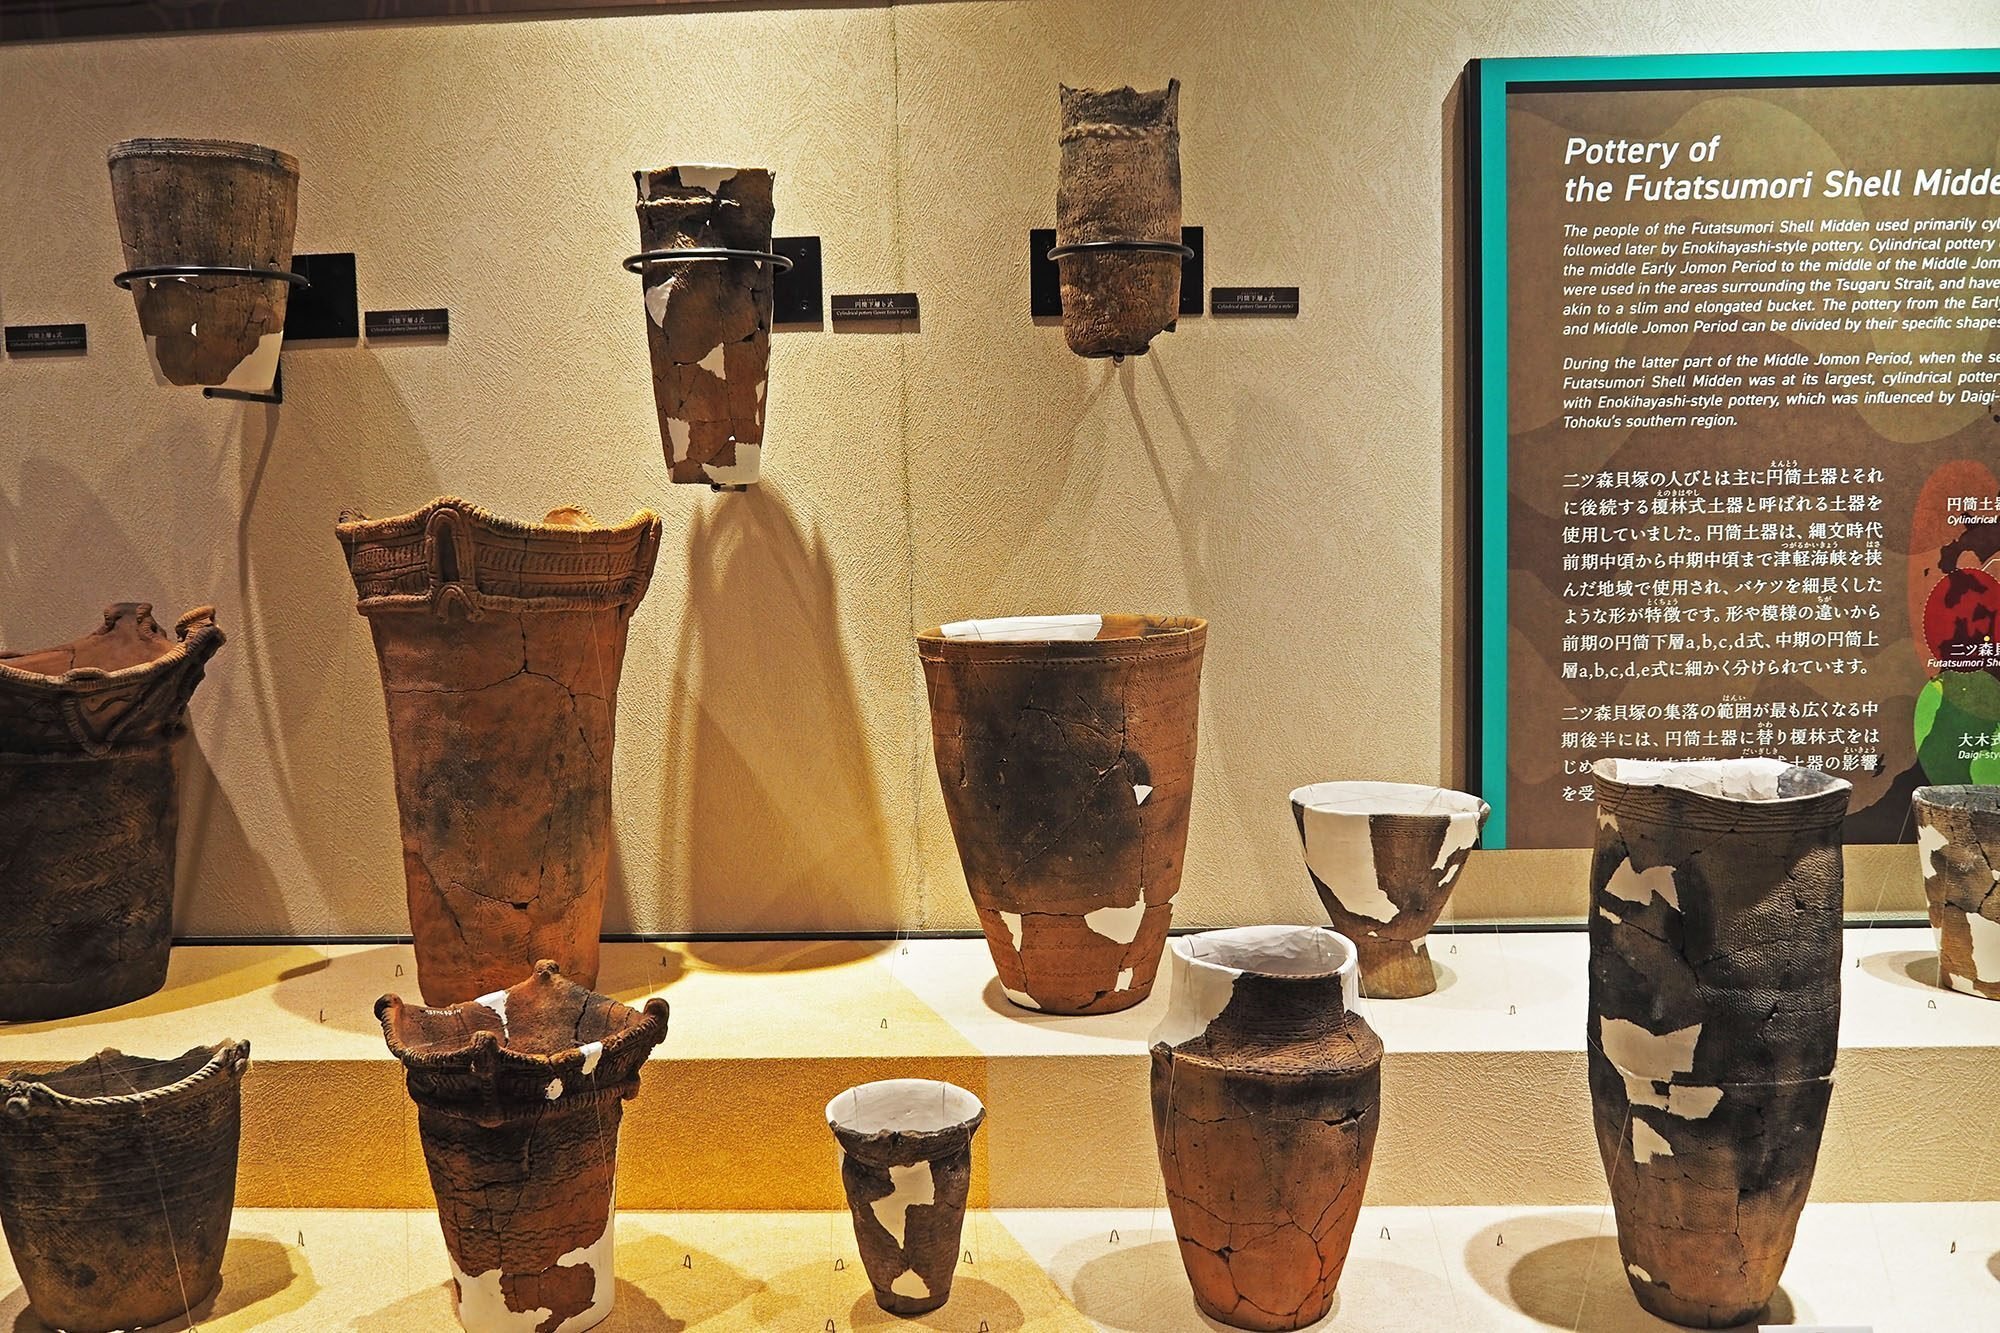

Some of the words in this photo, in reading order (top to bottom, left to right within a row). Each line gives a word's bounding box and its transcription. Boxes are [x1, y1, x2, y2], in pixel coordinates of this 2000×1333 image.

[1565, 138, 1679, 169] Pottery
[1689, 135, 1721, 162] of
[1566, 176, 1612, 202] the
[1625, 173, 1811, 201] Futatsumori
[1823, 169, 1901, 197] Shell
[1913, 168, 2000, 195] Midde
[1564, 225, 1587, 236] The
[1593, 224, 1639, 239] people
[1645, 223, 1659, 235] of
[1664, 223, 1685, 234] the
[1692, 221, 1774, 234] Futatsumori
[1780, 220, 1814, 233] Shell
[1820, 219, 1870, 232] Midden
[1876, 219, 1909, 231] used
[1914, 217, 1977, 233] primarily
[1564, 243, 1621, 256] followed
[1626, 243, 1657, 255] later
[1661, 242, 1678, 257] by
[1682, 240, 1807, 256] Enokihayashi-style
[1811, 240, 1863, 254] pottery.
[1869, 238, 1941, 253] Cylindrical
[1945, 239, 1995, 252] pottery
[1564, 264, 1584, 276] the
[1590, 263, 1636, 275] middle
[1641, 262, 1676, 277] Early
[1680, 262, 1726, 273] Jomon
[1732, 260, 1777, 272] Period
[1782, 261, 1794, 272] to
[1800, 259, 1821, 271] the
[1826, 258, 1872, 271] middle
[1877, 258, 1891, 270] of
[1895, 258, 1917, 270] the
[1922, 257, 1967, 269] Middle
[1564, 286, 1596, 295] were
[1601, 283, 1634, 295] used
[1638, 282, 1650, 294] in
[1655, 282, 1676, 294] the
[1680, 284, 1717, 293] areas
[1722, 280, 1805, 294] surrounding
[1810, 279, 1831, 291] the
[1836, 278, 1890, 293] Tsugaru
[1894, 277, 1934, 291] Strait,
[1939, 277, 1965, 289] and
[1969, 277, 2000, 288] have
[1563, 303, 1591, 315] akin
[1598, 304, 1610, 314] to
[1616, 305, 1623, 314] a
[1630, 302, 1658, 314] slim
[1664, 301, 1689, 313] and
[1695, 300, 1762, 315] elongated
[1767, 299, 1815, 311] bucket.
[1823, 298, 1846, 310] The
[1852, 299, 1902, 313] pottery
[1907, 297, 1938, 309] from
[1944, 297, 1966, 308] the
[1972, 296, 2000, 311] Earl
[1563, 323, 1589, 335] and
[1593, 322, 1638, 334] Middle
[1642, 322, 1688, 333] Jomon
[1694, 320, 1738, 332] Period
[1742, 322, 1765, 331] can
[1770, 319, 1787, 331] be
[1791, 318, 1841, 331] divided
[1845, 318, 1861, 332] by
[1866, 317, 1898, 329] their
[1902, 317, 1952, 331] specific
[1563, 357, 1609, 372] During
[1615, 357, 1636, 368] the
[1642, 357, 1679, 368] latter
[1683, 356, 1712, 370] part
[1718, 355, 1732, 367] of
[1737, 355, 1758, 366] the
[1764, 354, 1808, 366] Middle
[1814, 353, 1860, 365] Jomon
[1866, 352, 1912, 365] Period,
[1920, 352, 1955, 363] when
[1962, 351, 1982, 363] the
[1564, 376, 1645, 389] Futatsumori
[1652, 375, 1685, 387] Shell
[1693, 375, 1742, 386] Midden
[1749, 377, 1775, 385] was
[1782, 375, 1796, 385] at
[1802, 373, 1818, 385] its
[1825, 373, 1875, 387] largest,
[1883, 371, 1952, 386] cylindrical
[1958, 372, 2000, 385] potter
[1564, 397, 1591, 408] with
[1598, 395, 1722, 410] Enokihayashi-style
[1728, 395, 1779, 408] pottery,
[1787, 392, 1825, 404] which
[1832, 395, 1858, 404] was
[1864, 391, 1933, 403] influenced
[1939, 391, 1955, 405] by
[1564, 415, 1621, 428] Tohoku's
[1626, 415, 1686, 427] southern
[1691, 414, 1737, 428] region.
[1770, 459, 1798, 467] えんとう
[1563, 468, 1884, 488] 二ツ森貝塚の人びとは主に円筒土器とそれ
[1656, 489, 1700, 497] えのきはやし
[1565, 494, 1882, 516] に後続する榎林式土器と呼ばれる土器を
[1947, 515, 1997, 526] Cylindrical
[1562, 522, 1883, 543] 使用していました。円筒土器は、縄文時代
[1781, 541, 1838, 549] つがるかいきょう
[1866, 540, 1881, 548] はさ
[1564, 577, 1882, 598] んだ地域で使用され、バケツを細長くした
[1647, 598, 1679, 606] とくちょう
[1817, 595, 1832, 603] ちが
[1565, 602, 1880, 624] ような形が特徴です。形や模様の違いから
[1927, 658, 1984, 668] Futatsumori
[1722, 694, 1746, 702] はんい
[1562, 701, 1878, 722] 二ツ森貝塚の集落の範囲が最も広くなる中
[1757, 721, 1773, 729] かわ
[1561, 728, 1879, 749] 期後半には、円筒土器に替り榎林式をは
[1842, 746, 1877, 754] えいきょう
[1958, 750, 2000, 761] Daigi-sty
